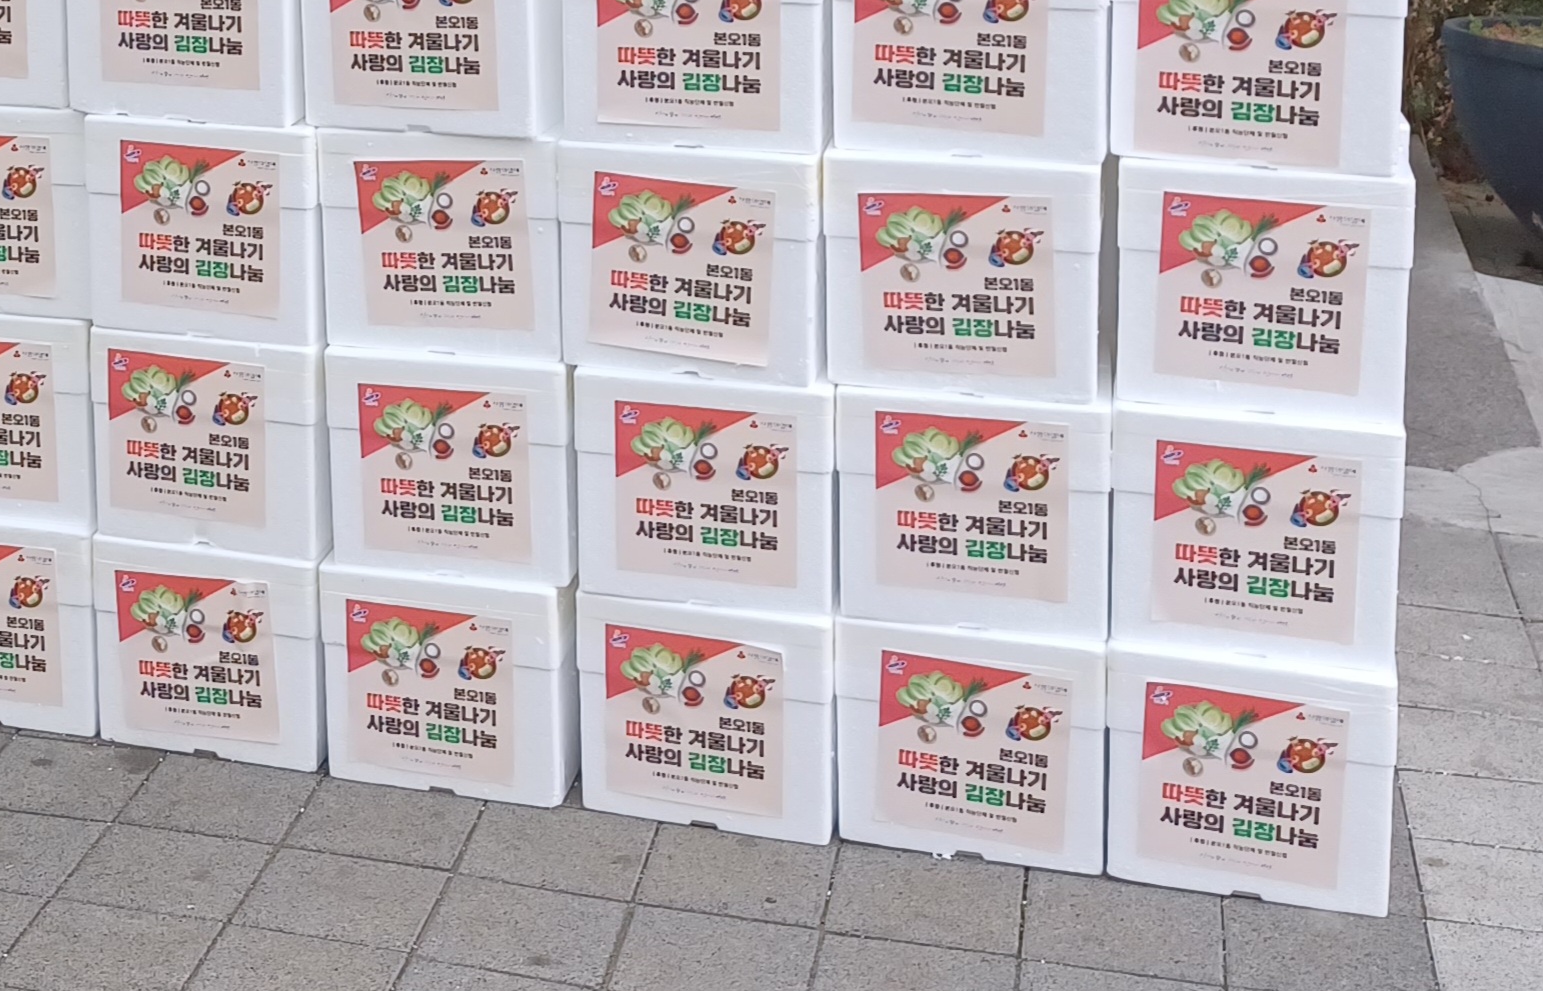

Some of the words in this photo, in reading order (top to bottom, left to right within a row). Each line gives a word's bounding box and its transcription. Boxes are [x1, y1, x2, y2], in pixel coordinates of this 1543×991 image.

[117, 9, 169, 29] 따뜻한
[173, 13, 242, 33] 겨울나기
[117, 32, 169, 51] 사랑의
[173, 35, 243, 55] 김장나눔
[713, 32, 762, 47] 본오1동
[617, 46, 676, 66] 따뜻한
[682, 49, 761, 70] 겨울나기
[1268, 59, 1322, 77] 본오1동
[617, 70, 676, 89] 사랑의
[681, 72, 761, 94] 김장나눔
[1158, 70, 1225, 94] 따뜻한
[1232, 76, 1321, 101] 겨울나기
[1156, 96, 1224, 118] 사랑의
[1230, 101, 1320, 126] 김장나눔
[467, 234, 513, 249] 본오1동
[380, 250, 436, 270] 따뜻한
[440, 252, 514, 272] 겨울나기
[382, 274, 438, 292] 사랑의
[441, 275, 516, 294] 김장나눔
[983, 276, 1035, 292] 본오1동
[882, 291, 946, 311] 따뜻한
[951, 294, 1035, 315] 겨울나기
[883, 315, 946, 335] 사랑의
[951, 317, 1036, 339] 김장나눔
[208, 433, 250, 450] 본오1동
[126, 439, 177, 461] 따뜻한
[181, 446, 249, 471] 겨울나기
[126, 460, 177, 482] 사랑의
[181, 467, 250, 492] 김장나눔
[731, 488, 779, 505] 본오1동
[635, 497, 694, 520] 따뜻한
[700, 503, 778, 528] 겨울나기
[635, 520, 694, 542] 사랑의
[699, 526, 779, 551] 김장나눔
[1283, 536, 1337, 555] 본오1동
[1175, 542, 1241, 568] 따뜻한
[1247, 551, 1335, 579] 겨울나기
[1173, 567, 1239, 592] 사랑의
[1246, 575, 1335, 603] 김장나눔
[453, 687, 497, 706] 본오1동
[366, 692, 420, 716] 따뜻한
[425, 700, 497, 727] 겨울나기
[366, 714, 420, 737] 사랑의
[425, 722, 498, 749] 김장나눔
[898, 748, 960, 776] 따뜻한
[966, 760, 1047, 791] 겨울나기
[999, 748, 1049, 769] 본오1동
[896, 771, 958, 798] 사랑의
[964, 783, 1046, 814] 김장나눔
